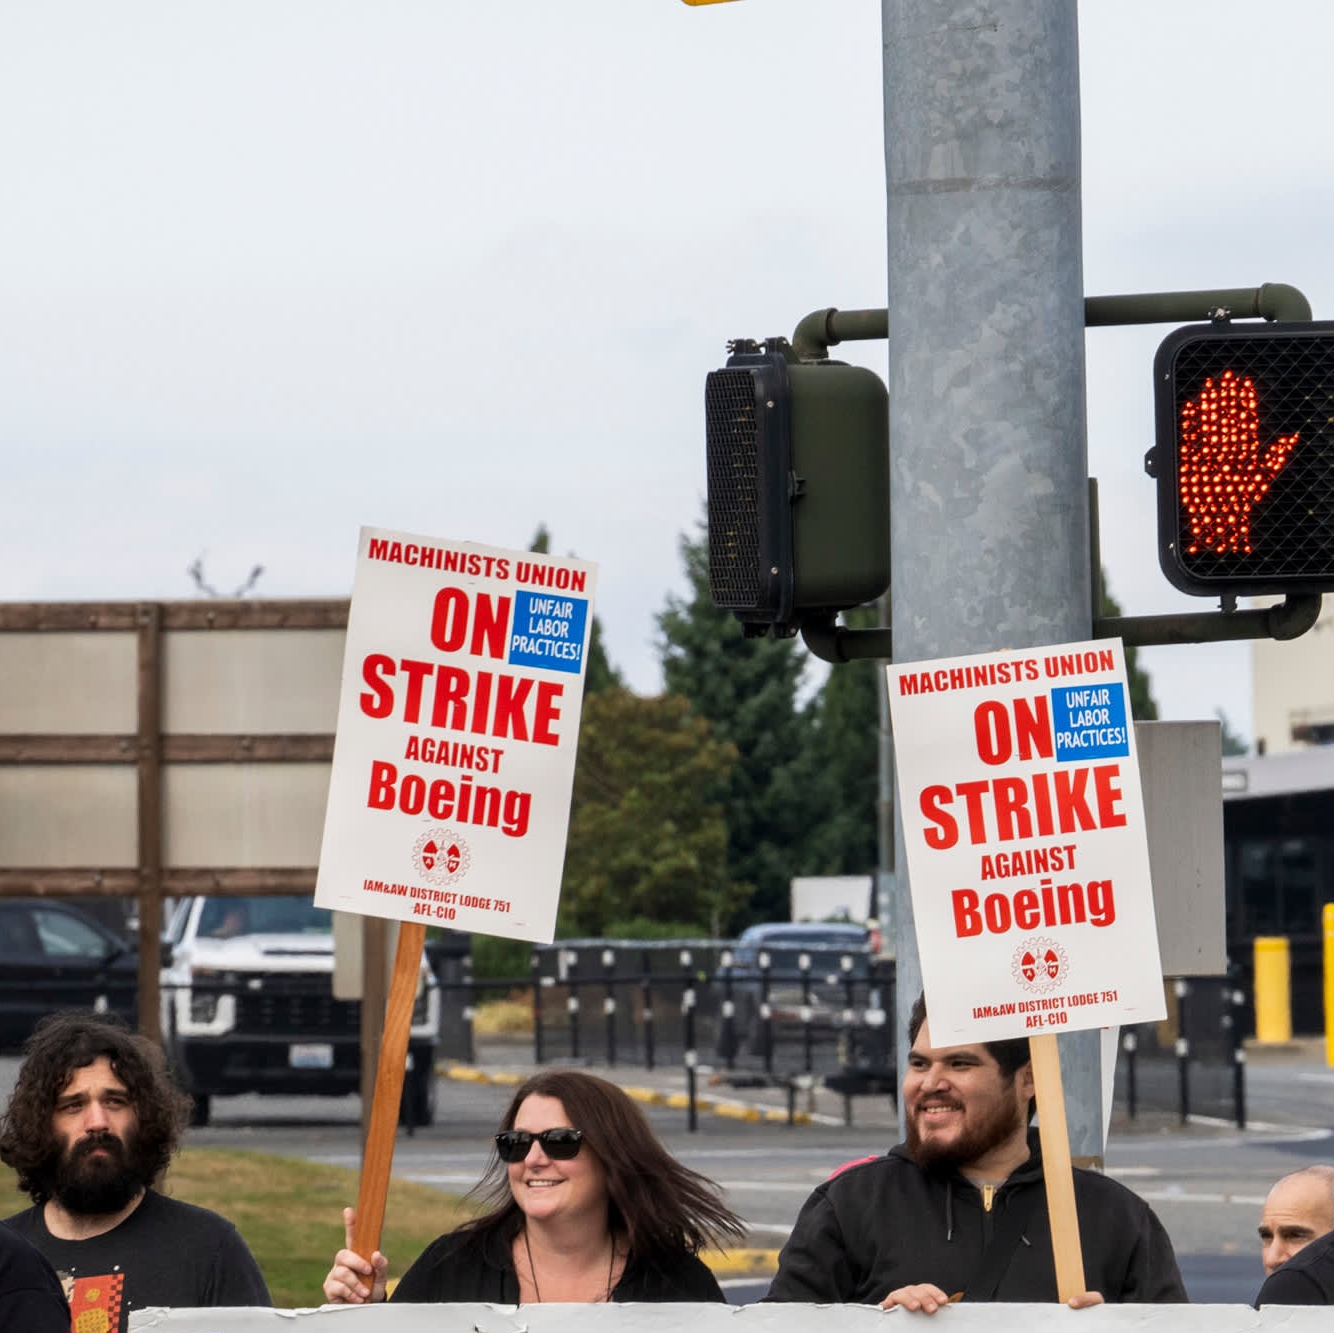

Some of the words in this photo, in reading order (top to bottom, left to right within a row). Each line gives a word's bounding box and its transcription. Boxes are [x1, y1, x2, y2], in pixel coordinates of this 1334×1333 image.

[369, 538, 510, 580] MACHINISTS
[515, 562, 586, 592] UNION
[430, 587, 511, 660] ON
[530, 598, 572, 618] UNFAIR
[529, 618, 568, 637] LABOR
[512, 635, 580, 660] PRACTICES!
[899, 659, 1039, 696] MACHINISTS
[1044, 650, 1114, 678] UNION
[359, 654, 564, 746] STRIKE
[1066, 689, 1110, 708] UNFAIR
[974, 695, 1054, 766] ON
[1070, 709, 1110, 727] LABOR
[405, 735, 504, 774] AGAINST
[1057, 728, 1125, 748] PRACTICES!
[367, 760, 532, 838] Boeing
[919, 764, 1127, 850] STRIKE
[981, 844, 1076, 880] AGAINST
[363, 880, 408, 896] IAM&AW
[410, 886, 457, 906] DISTRICT
[459, 894, 491, 910] LODGE
[493, 899, 510, 913] 751
[413, 902, 456, 920] AFL-CIO
[951, 878, 1116, 938] Boeing
[973, 1001, 1017, 1019] IAM&AW
[1019, 996, 1066, 1013] DISTRICT
[1067, 993, 1099, 1007] LODGE
[1102, 990, 1119, 1002] 751
[1026, 1012, 1068, 1028] AFL-CIO
